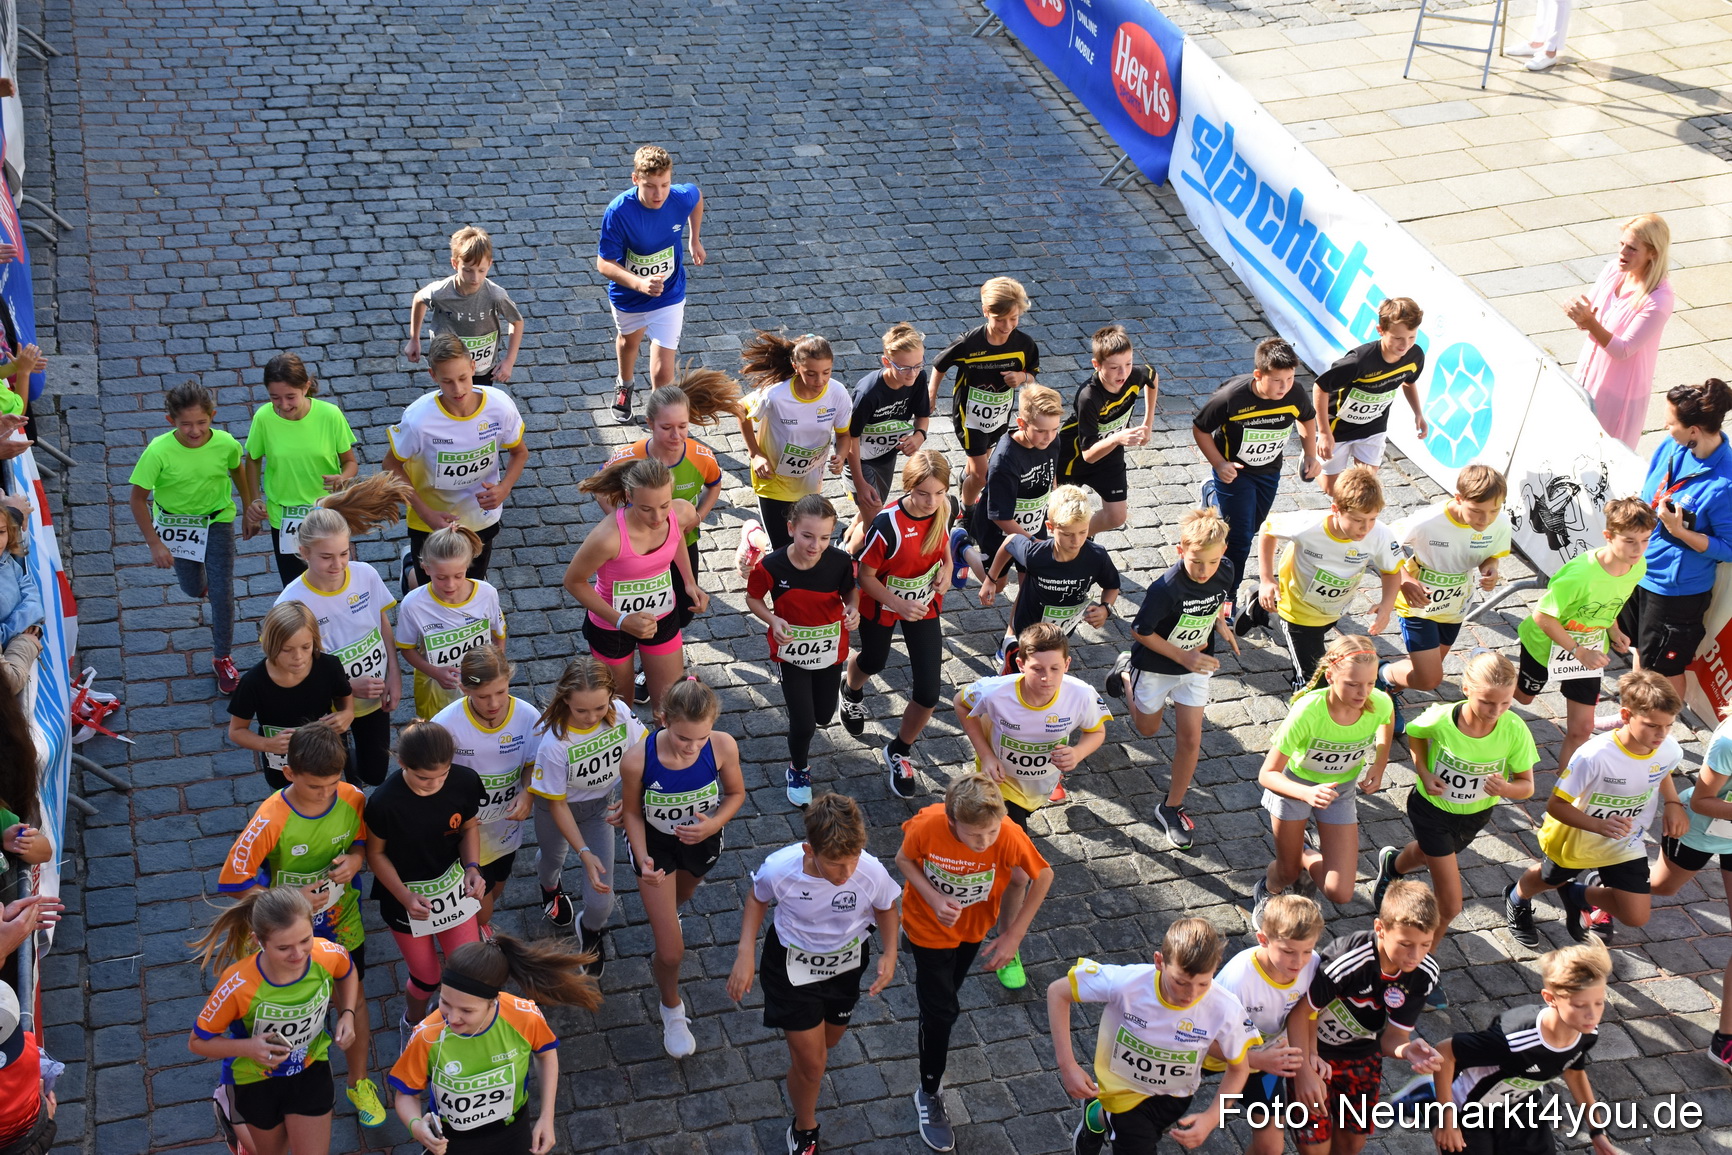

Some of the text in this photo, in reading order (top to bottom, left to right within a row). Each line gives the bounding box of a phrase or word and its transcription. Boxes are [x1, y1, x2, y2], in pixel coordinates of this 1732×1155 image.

[1077, 9, 1098, 37] ONLINE
[1075, 36, 1095, 65] MOBILE
[1114, 28, 1170, 122] Hervis
[628, 251, 671, 265] BOCK
[630, 262, 668, 276] 4003
[971, 390, 1013, 404] BOCK
[971, 404, 1009, 419] 4033
[864, 420, 912, 434] BOCK
[440, 443, 493, 462] BOCK
[1246, 438, 1284, 454] 4034
[1248, 454, 1276, 462] JULIAN
[443, 457, 488, 477] 4049
[619, 575, 669, 594] BOCK
[1038, 576, 1078, 585] Neumarkter
[1425, 570, 1468, 585] BOCK
[1038, 582, 1068, 593] Stadtlauf
[620, 592, 668, 613] 4047
[1425, 602, 1450, 613] JAKOB
[432, 623, 484, 647] BOCK
[437, 634, 485, 664] 4040
[785, 640, 832, 656] 4043
[793, 657, 822, 666] MAIKE
[1524, 678, 1541, 692] 13
[500, 735, 512, 744] 20
[573, 725, 624, 759] BOCK
[1315, 736, 1371, 751] BOCK
[576, 745, 623, 778] 4019
[1006, 752, 1051, 767] 400
[1311, 749, 1365, 763] 4010
[1443, 753, 1499, 773] BOCK
[587, 771, 614, 787] MARA
[1439, 768, 1486, 790] 401
[651, 789, 713, 805] BOCK
[654, 800, 710, 821] 4013
[232, 814, 270, 875] BOCK
[929, 852, 976, 867] Neumarkter
[930, 876, 983, 898] 4023
[432, 910, 465, 927] LUISA
[795, 950, 853, 968] 4022
[810, 968, 837, 976] ERIK
[199, 971, 246, 1022] BOCK
[263, 988, 325, 1020] BOCK
[262, 1007, 323, 1037] 4027
[1179, 1020, 1192, 1032] 20
[1176, 1030, 1208, 1040] Neumarkter
[492, 1048, 518, 1063] BOCK
[1121, 1031, 1196, 1064] BOCK
[1121, 1051, 1186, 1077] 4016
[436, 1069, 508, 1092] BOCK
[1133, 1073, 1167, 1085] LEON
[440, 1090, 505, 1113] 4029
[447, 1109, 495, 1125] CAROLA
